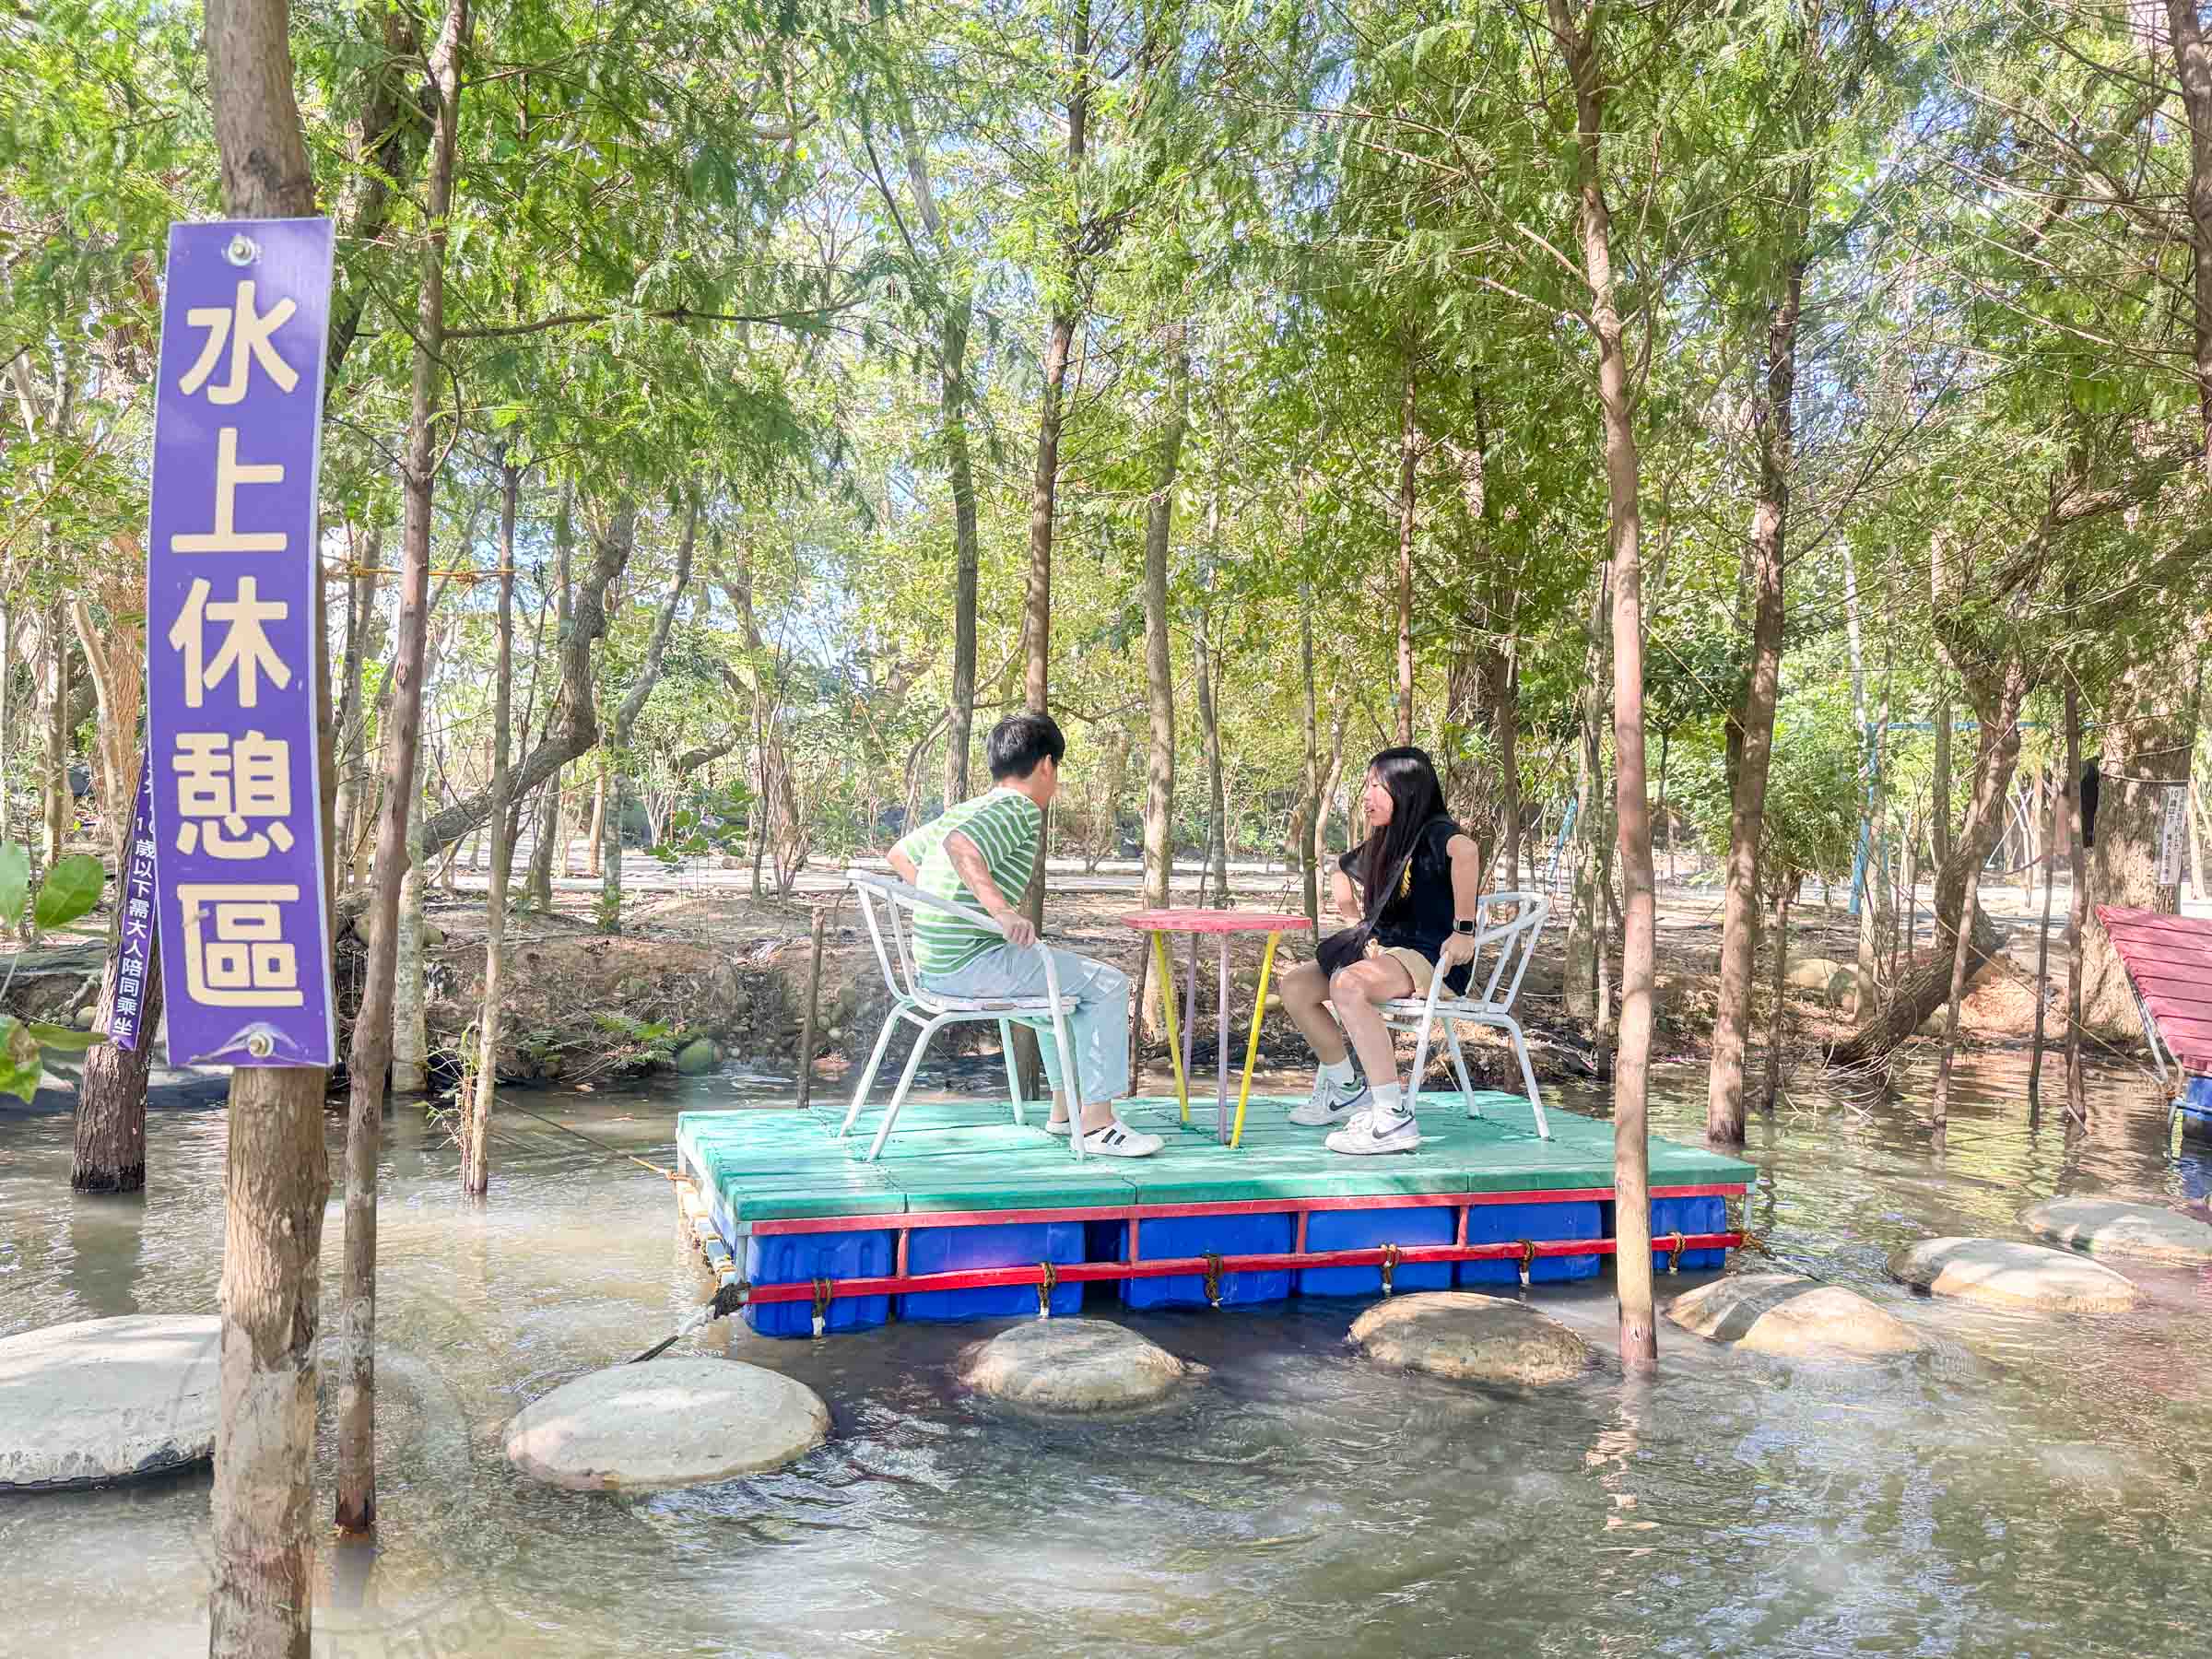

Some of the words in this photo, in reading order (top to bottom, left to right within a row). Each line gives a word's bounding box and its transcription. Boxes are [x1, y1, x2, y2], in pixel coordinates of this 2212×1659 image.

[169, 280, 300, 1007] 水上休憩區
